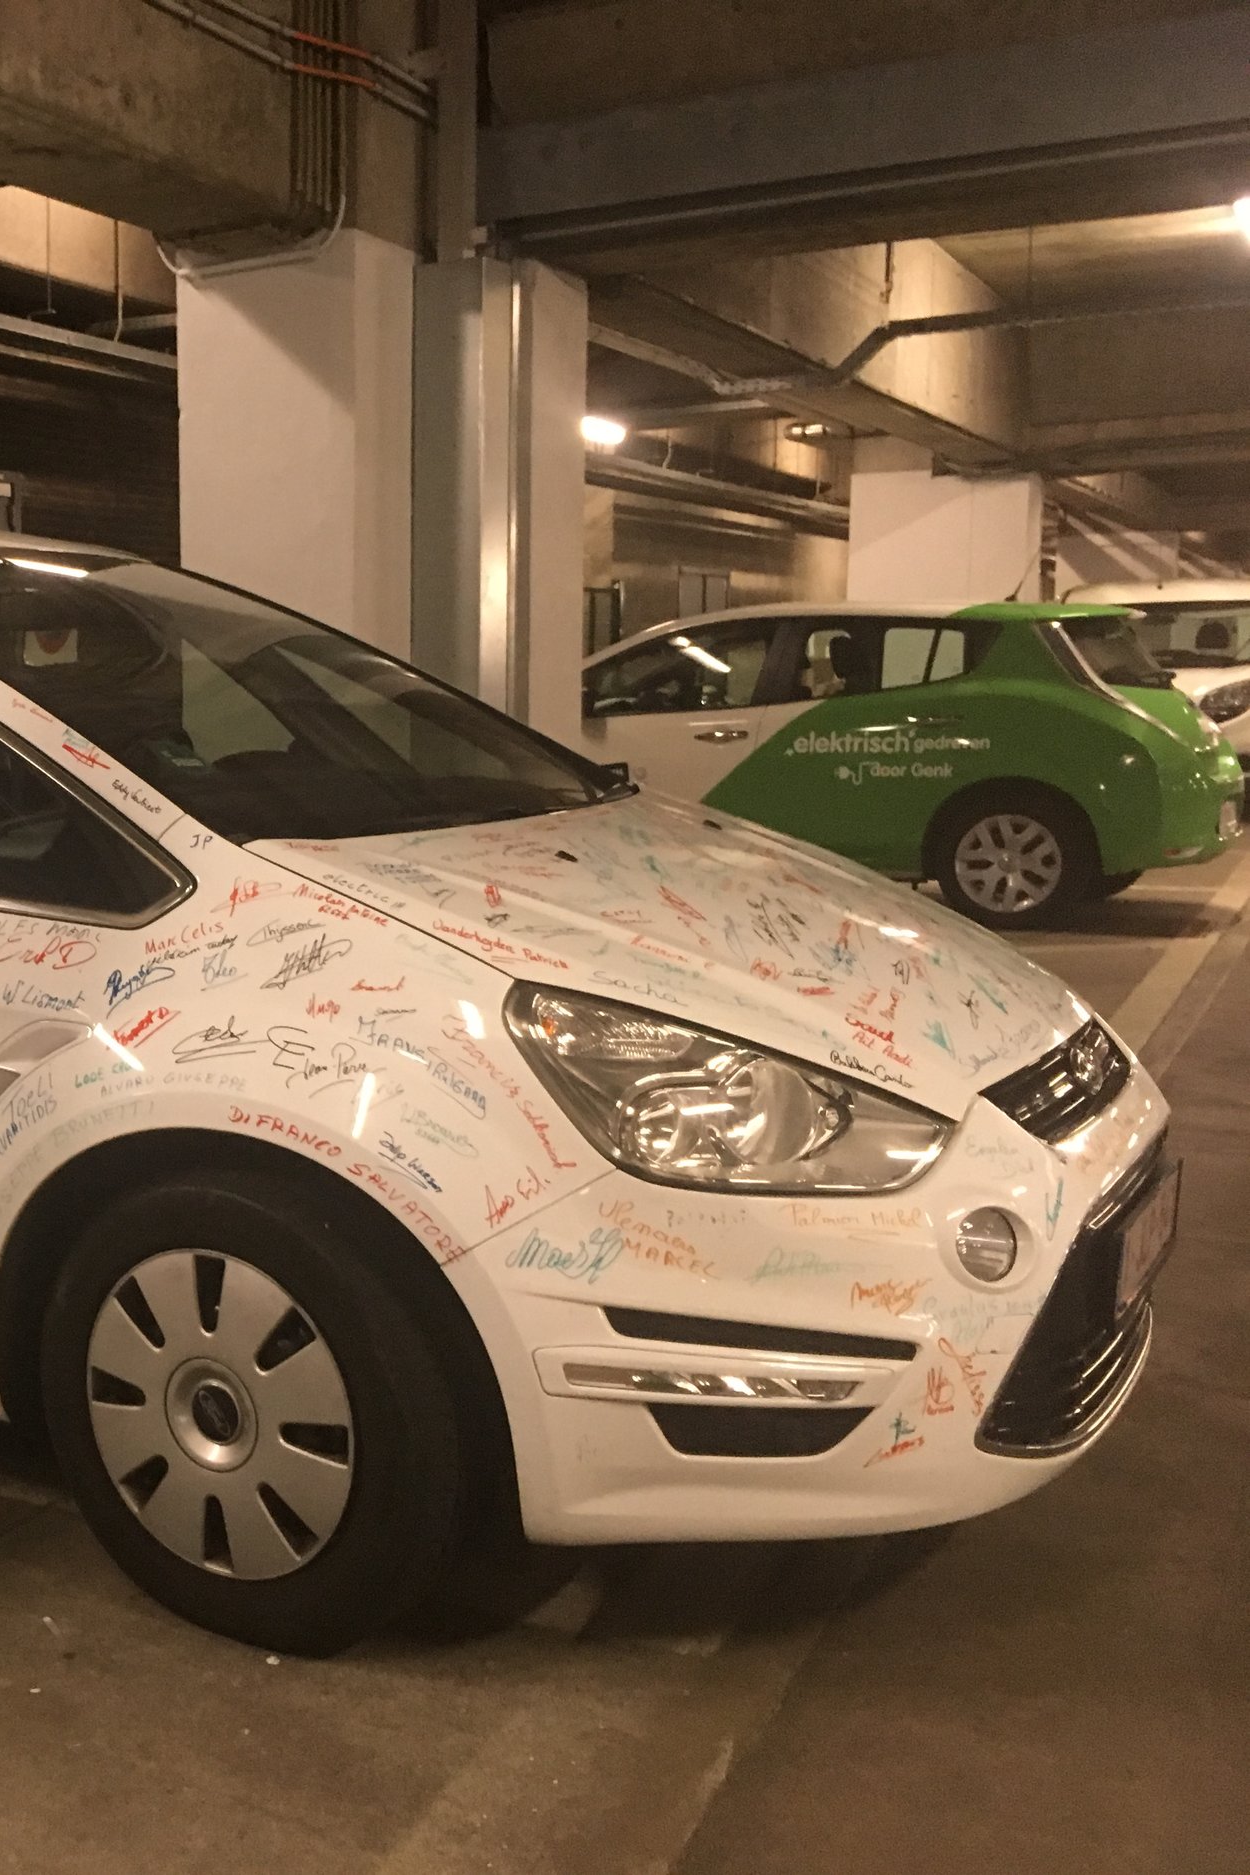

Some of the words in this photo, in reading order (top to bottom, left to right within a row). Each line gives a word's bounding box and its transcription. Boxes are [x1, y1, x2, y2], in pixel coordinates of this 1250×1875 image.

[793, 731, 910, 754] elektrisch
[914, 735, 991, 754] gedreen
[871, 763, 907, 778] door
[911, 763, 954, 778] Genk
[588, 970, 688, 1007] Sacha
[228, 1105, 251, 1124] DI
[256, 1114, 343, 1158] FRANCO
